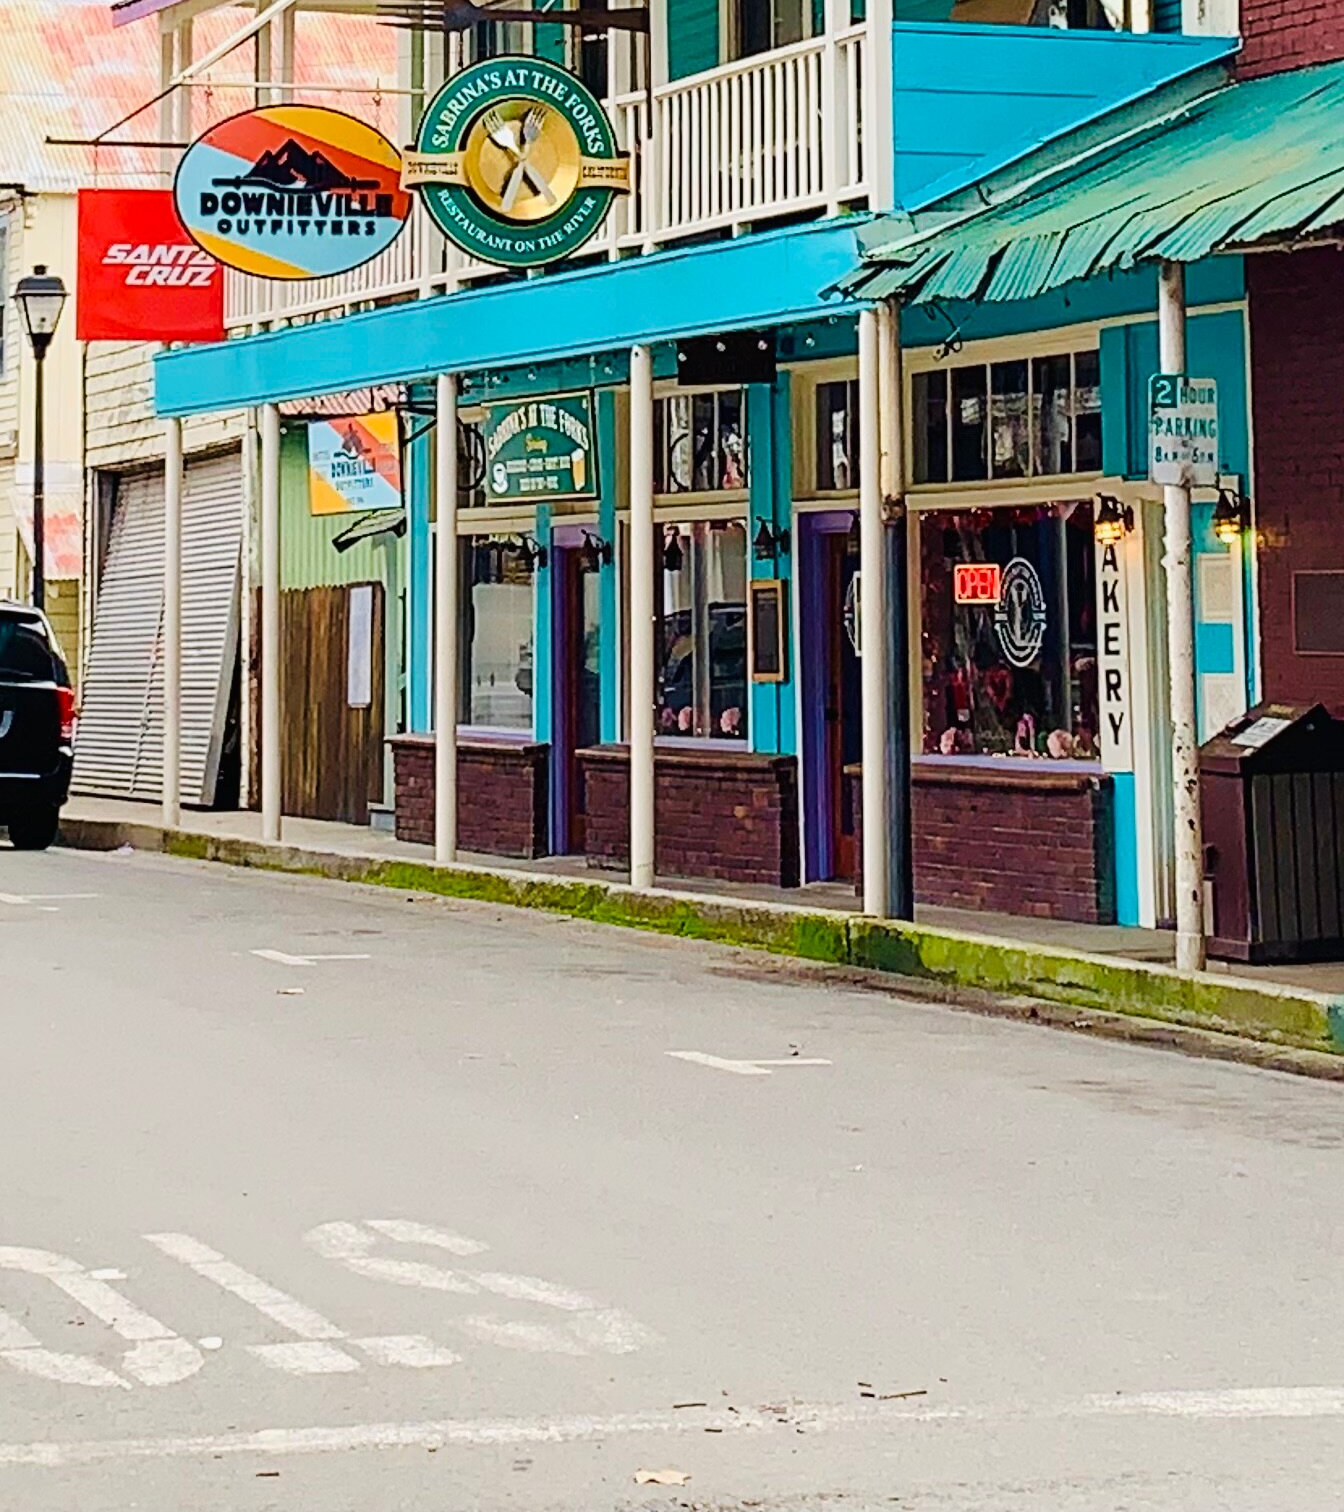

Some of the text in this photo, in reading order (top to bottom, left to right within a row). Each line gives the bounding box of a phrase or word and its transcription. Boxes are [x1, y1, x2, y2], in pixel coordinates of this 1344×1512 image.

[432, 69, 605, 154] SABRINA'S AT THE FORKS
[200, 192, 394, 217] DOWNIEVILLE
[217, 219, 377, 236] OUTFITTERS
[437, 189, 597, 253] RESTAURANT ON THE RIVER
[102, 244, 216, 265] SANTA
[125, 265, 217, 286] CRUZ
[1156, 380, 1215, 404] 2 HOUR
[1153, 416, 1217, 439] PARKING
[958, 568, 999, 599] OPEN
[1102, 545, 1124, 746] AKERY
